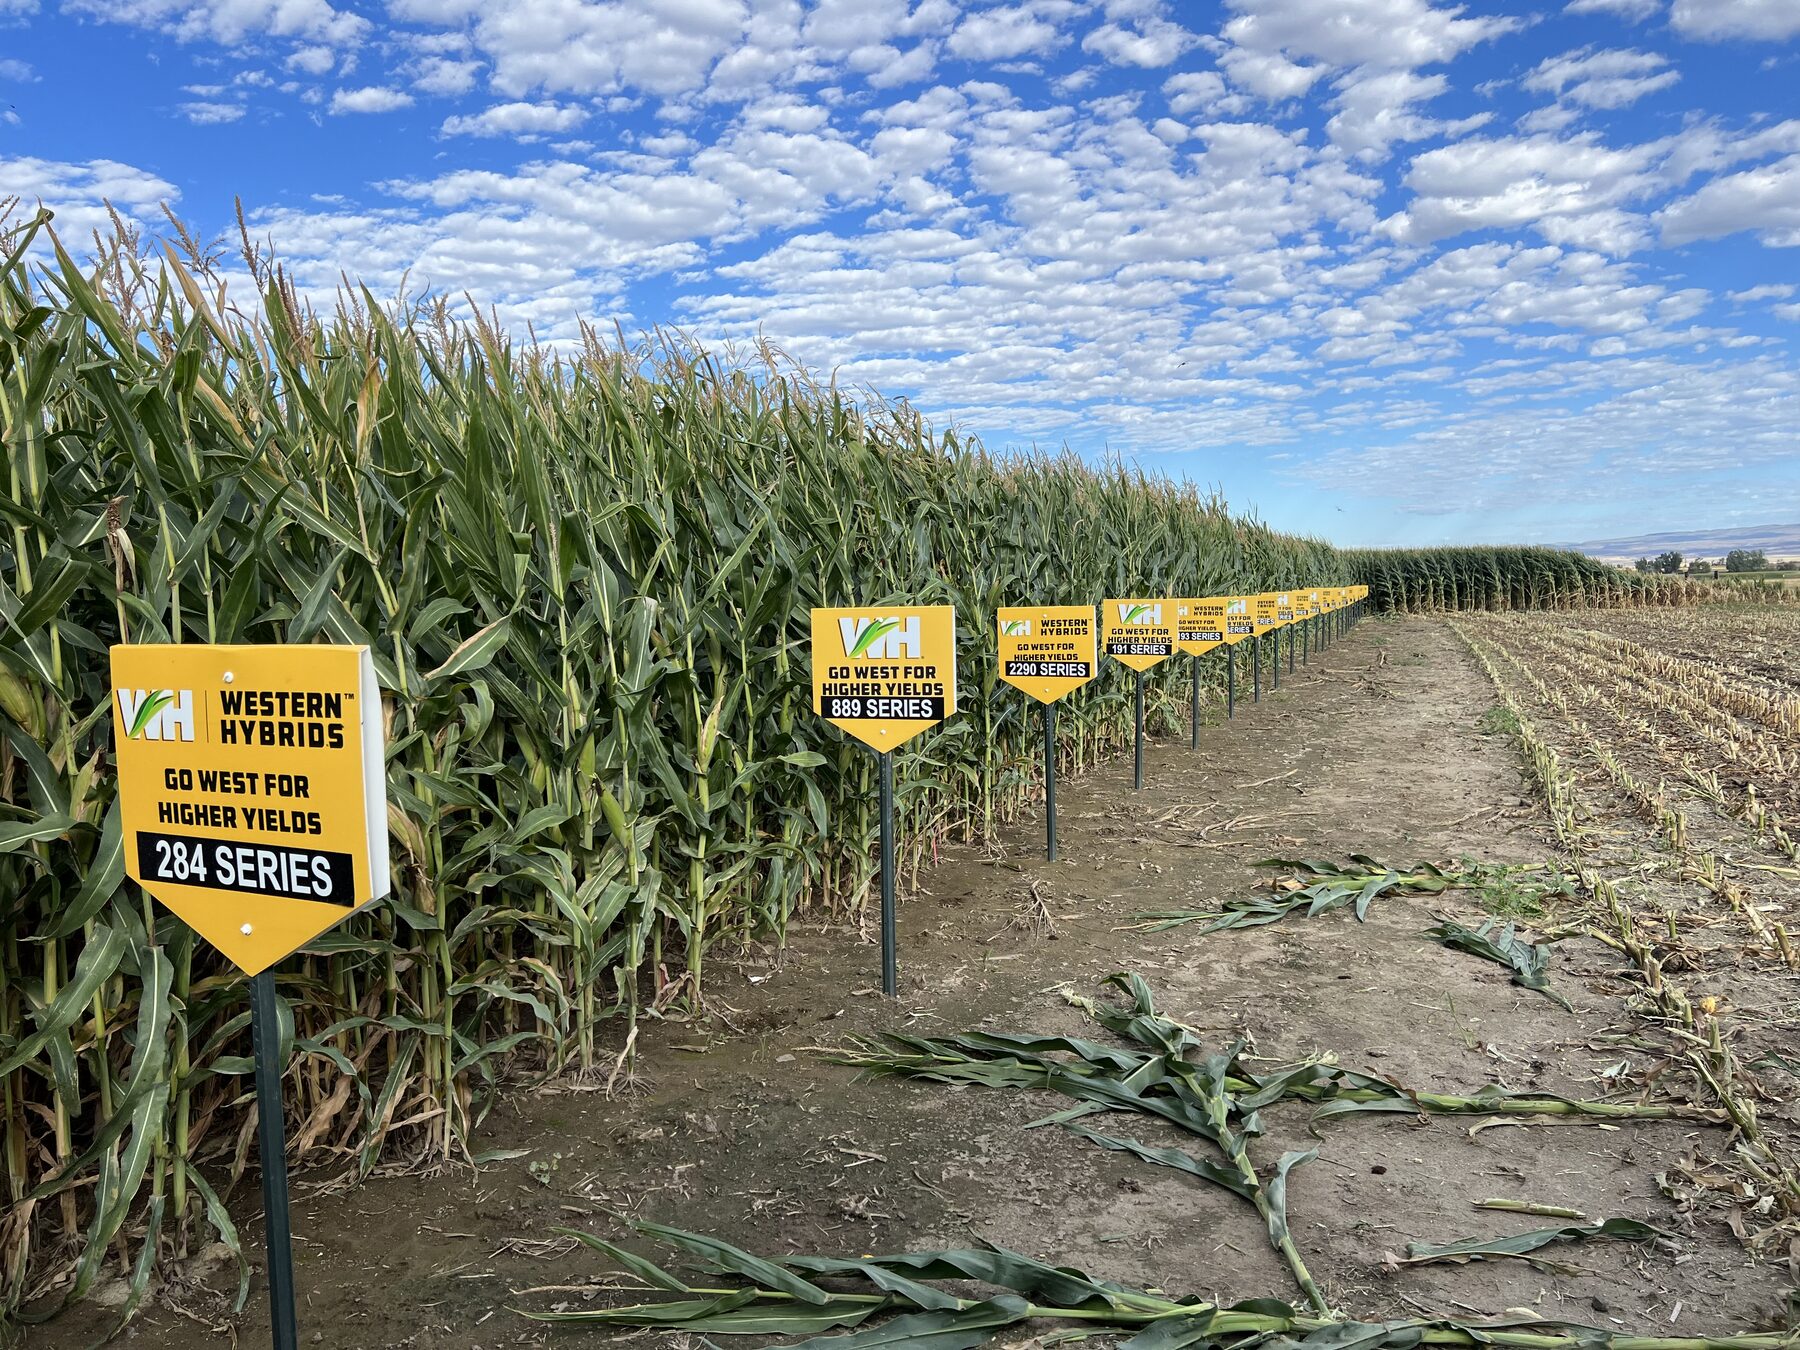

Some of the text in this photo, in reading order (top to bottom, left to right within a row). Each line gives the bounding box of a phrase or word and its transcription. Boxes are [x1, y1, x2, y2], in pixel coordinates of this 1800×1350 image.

[1117, 603, 1162, 625] WH
[999, 620, 1031, 636] WH
[1041, 627, 1089, 636] HYBRIDS
[838, 616, 921, 659] WH
[1107, 636, 1173, 644] HIGHER YIELDS
[1191, 632, 1221, 641] SERIES
[1017, 643, 1074, 651] GO WEST FOR
[1112, 645, 1166, 654] 191 SERIES
[1014, 653, 1079, 661] HIGHER YIELDS
[828, 666, 936, 679] GO WEST FOR
[1009, 663, 1086, 677] 2290 SERIES
[822, 683, 944, 696] HIGHER YIELDS
[117, 688, 195, 742] WH
[831, 698, 933, 719] 889 SERIES
[220, 719, 344, 749] HYBRIDS
[164, 768, 310, 799] GO WEST FOR
[158, 801, 322, 835] HIGHER YIELDS
[155, 839, 333, 897] 284 SERIES
